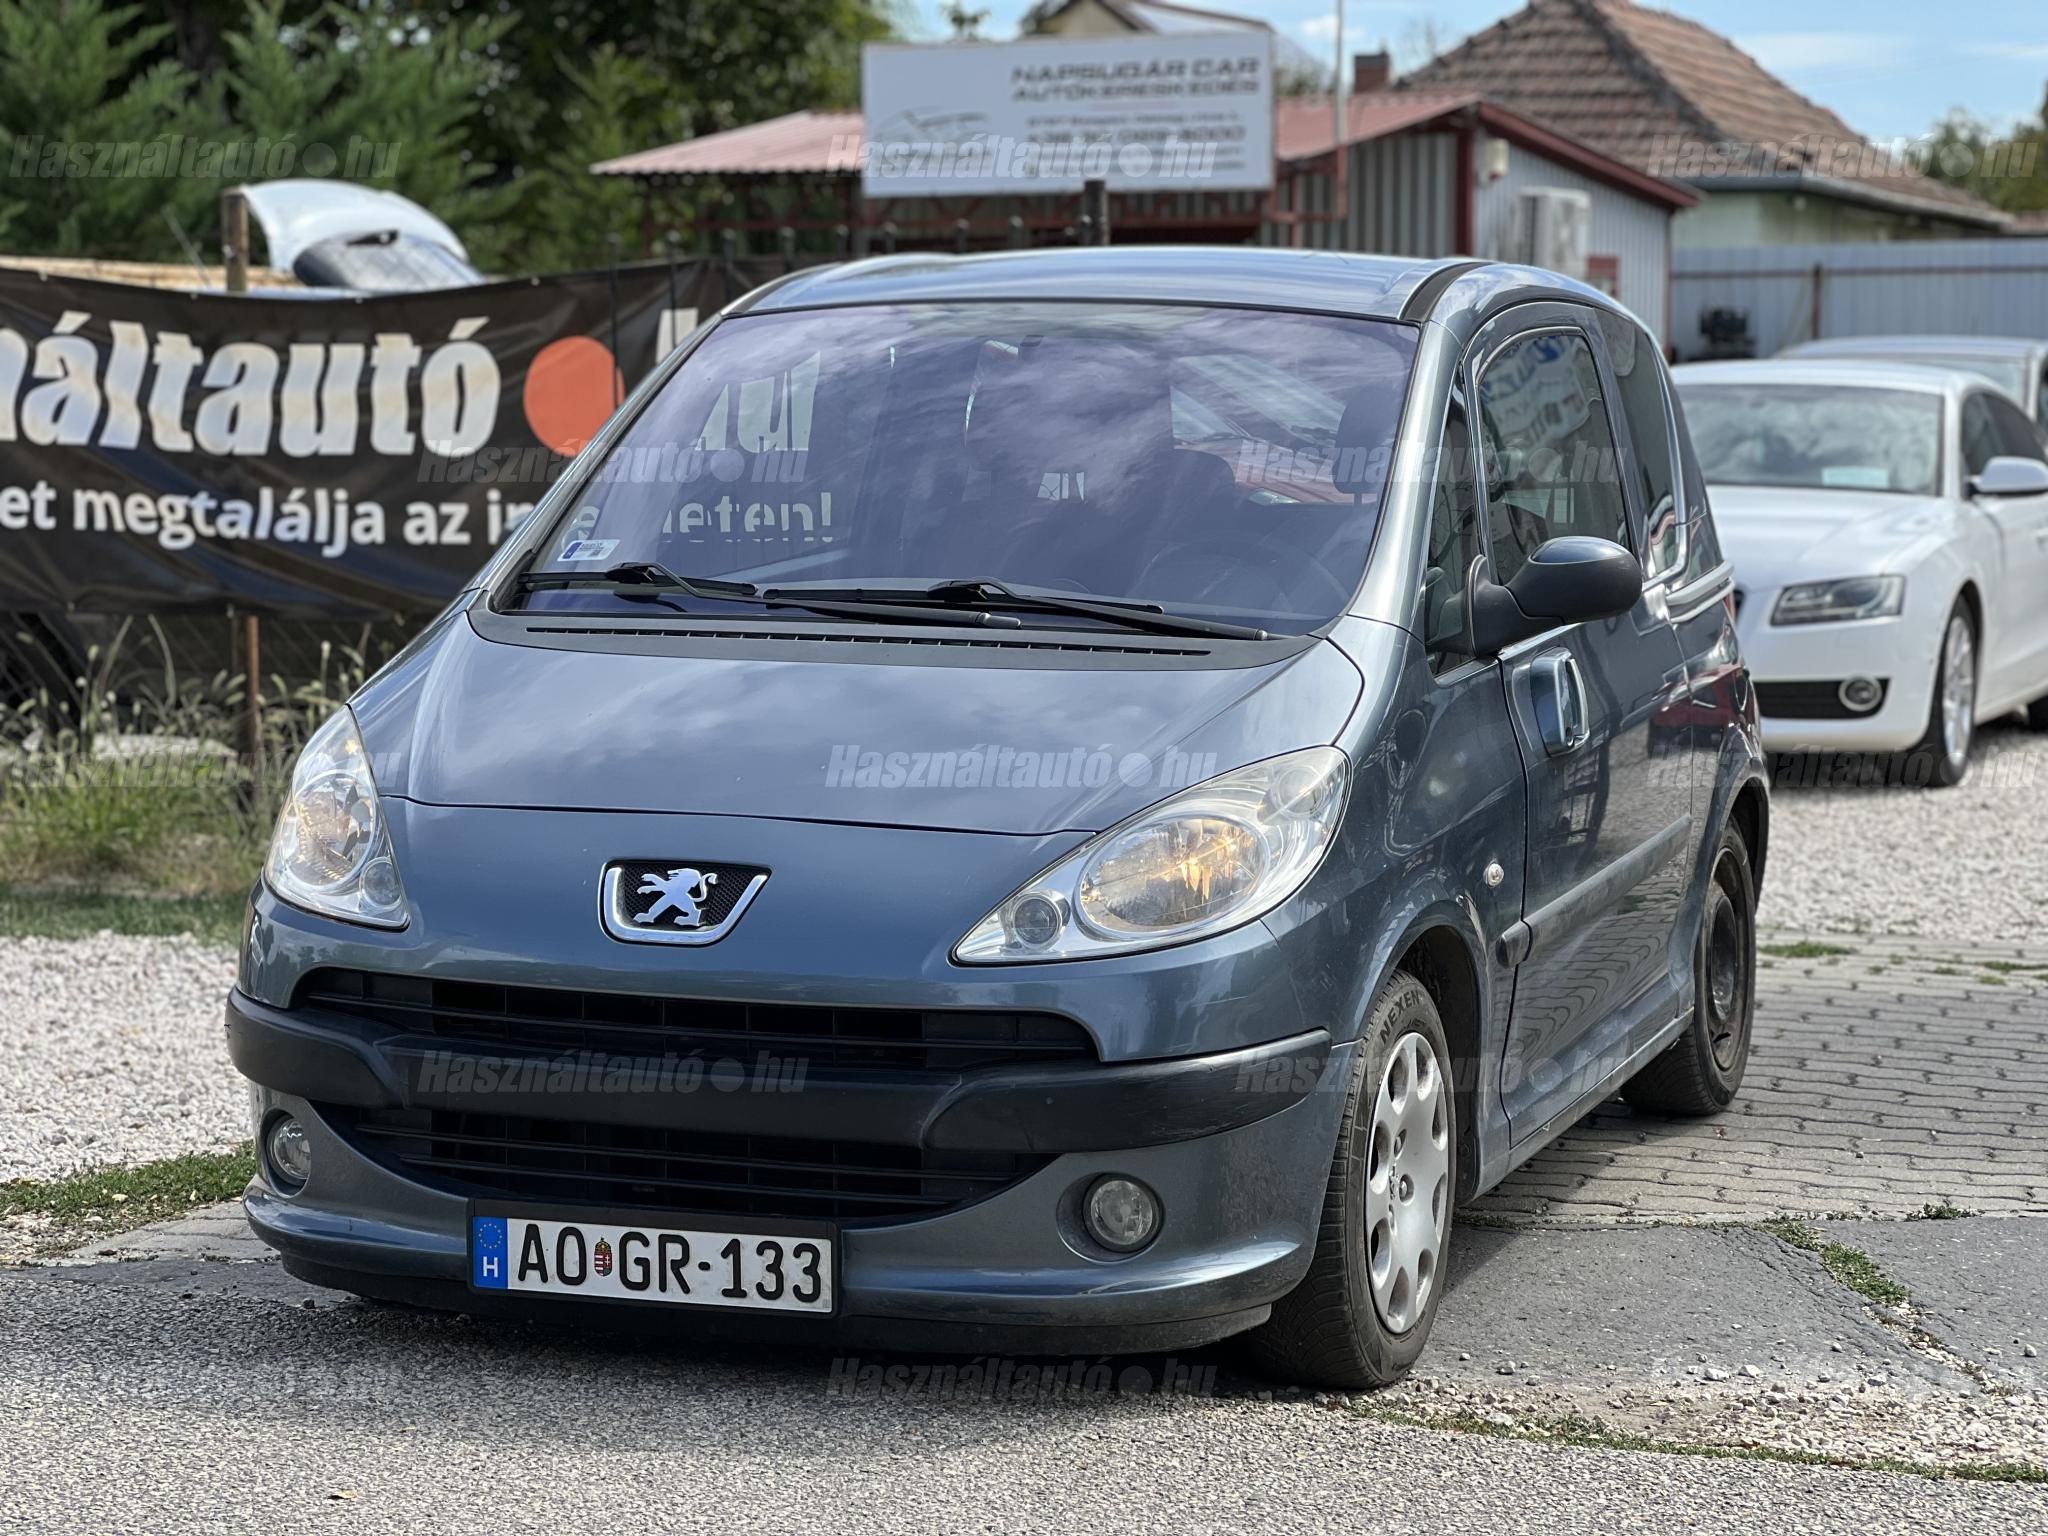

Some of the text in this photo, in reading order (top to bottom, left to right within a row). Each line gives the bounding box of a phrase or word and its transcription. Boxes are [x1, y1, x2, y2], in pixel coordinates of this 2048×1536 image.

[1193, 58, 1259, 79] CAR
[73, 486, 385, 558] megtalálja
[403, 502, 471, 545] az
[1380, 989, 1420, 1045] NEXEN
